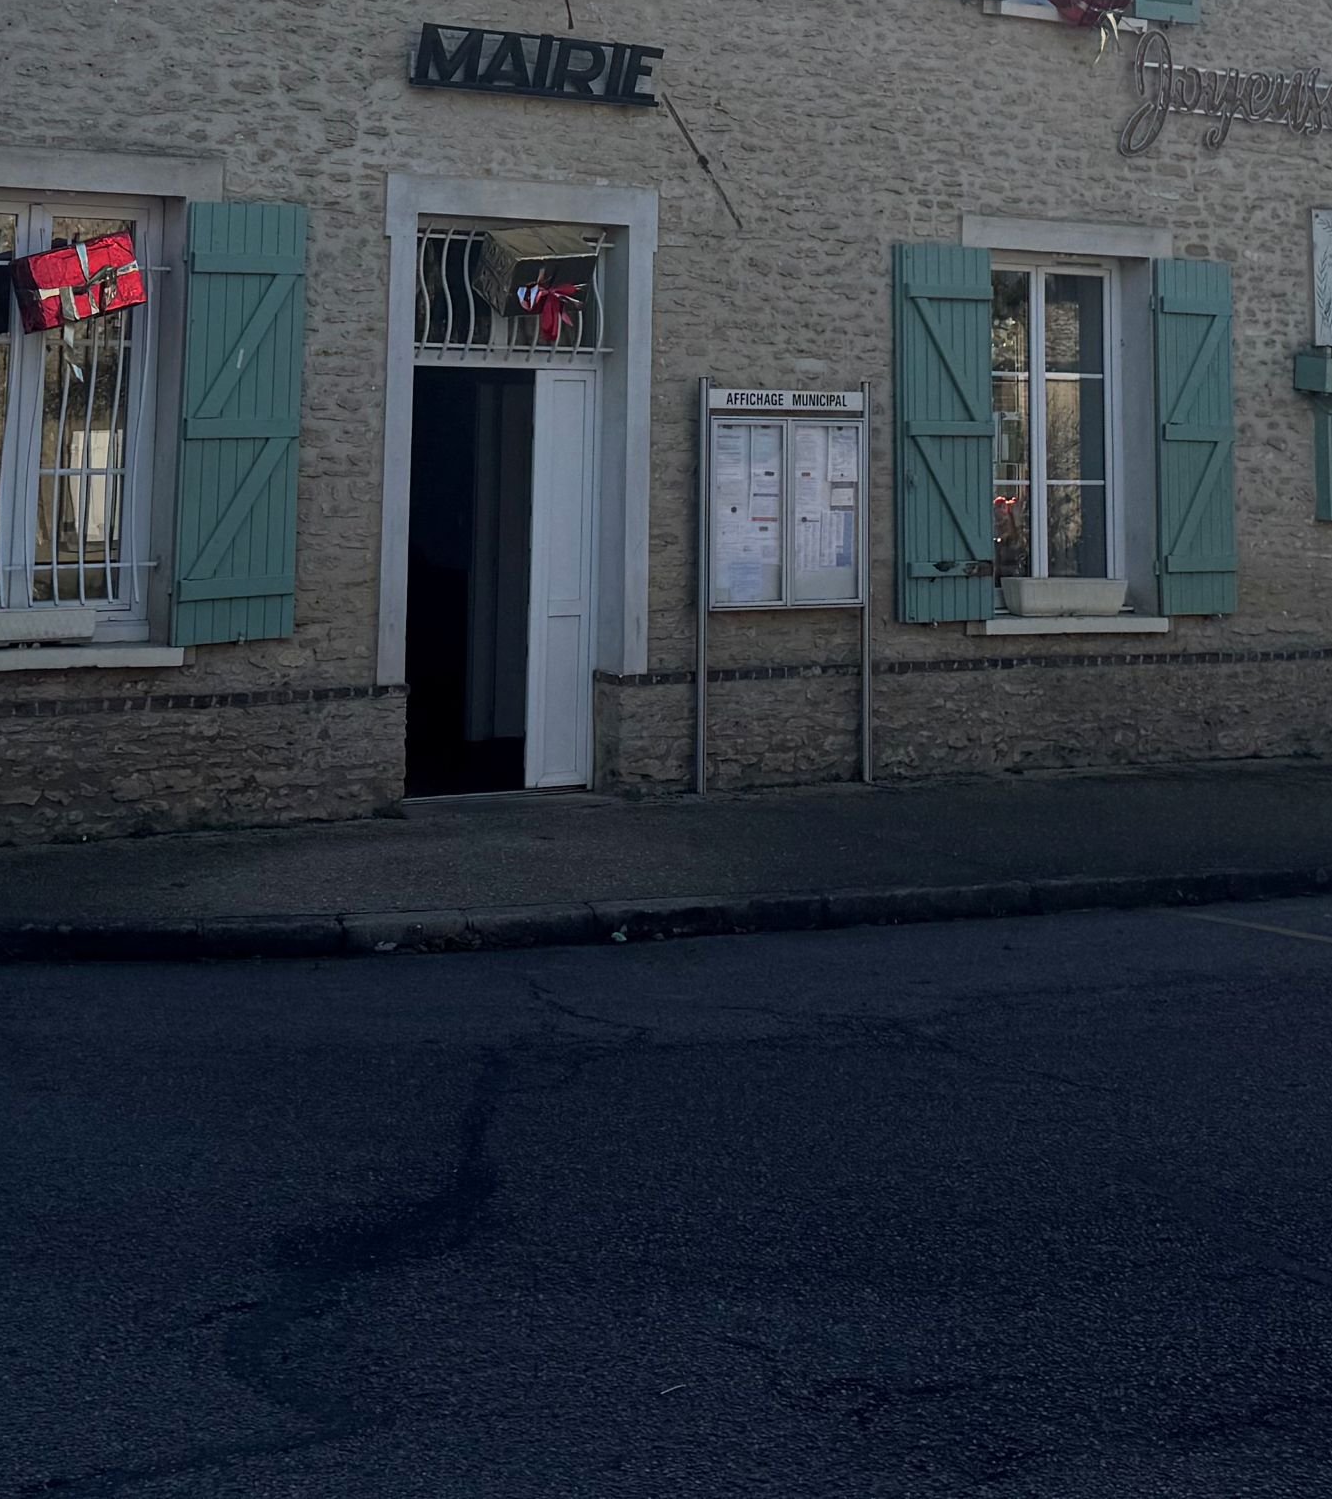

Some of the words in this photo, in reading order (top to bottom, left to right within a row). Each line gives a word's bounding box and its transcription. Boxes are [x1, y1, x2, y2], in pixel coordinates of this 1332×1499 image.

[414, 23, 664, 104] MAIRIE
[726, 393, 784, 406] AFFICHAGE
[792, 394, 848, 407] MUNICIPAL
